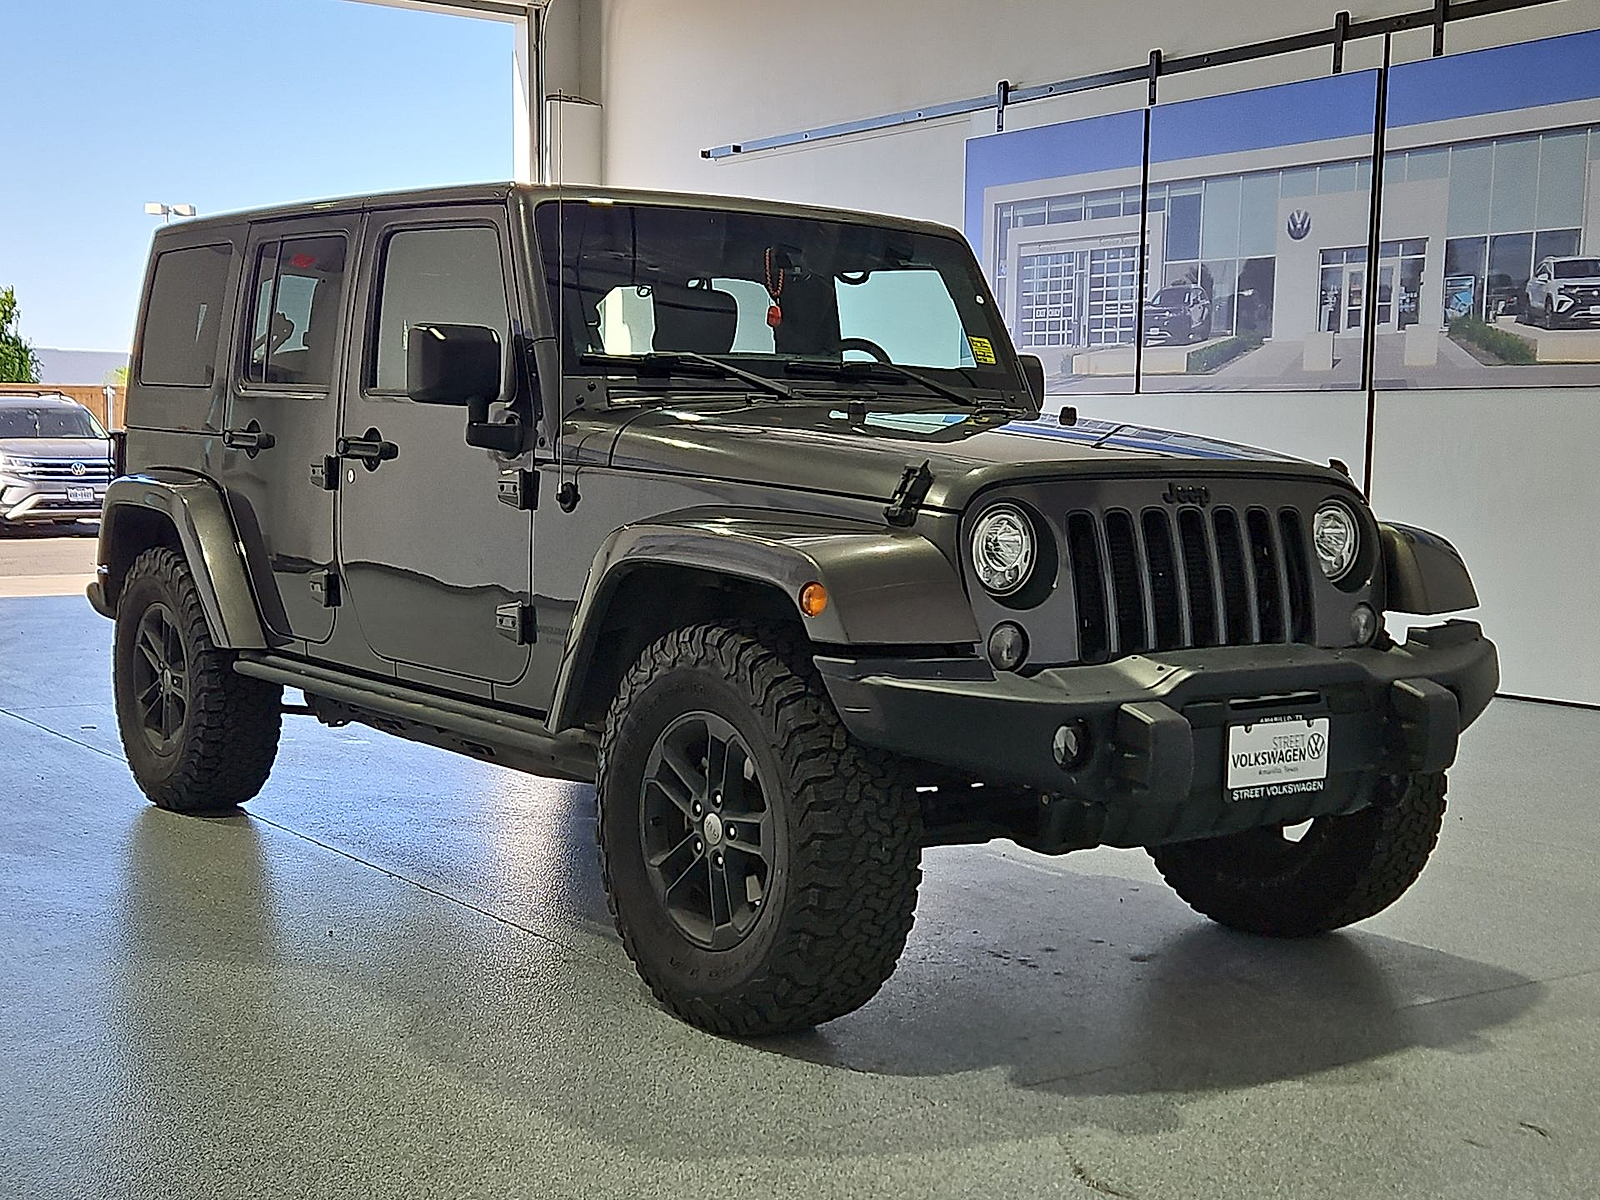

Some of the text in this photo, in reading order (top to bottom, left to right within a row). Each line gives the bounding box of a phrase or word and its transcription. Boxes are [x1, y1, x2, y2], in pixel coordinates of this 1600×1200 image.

[1162, 482, 1209, 508] Jeep
[1272, 734, 1305, 750] STREET
[1232, 748, 1306, 768] VOLKSWAGEN
[1232, 781, 1324, 801] STREET VOLKSWAGEN
